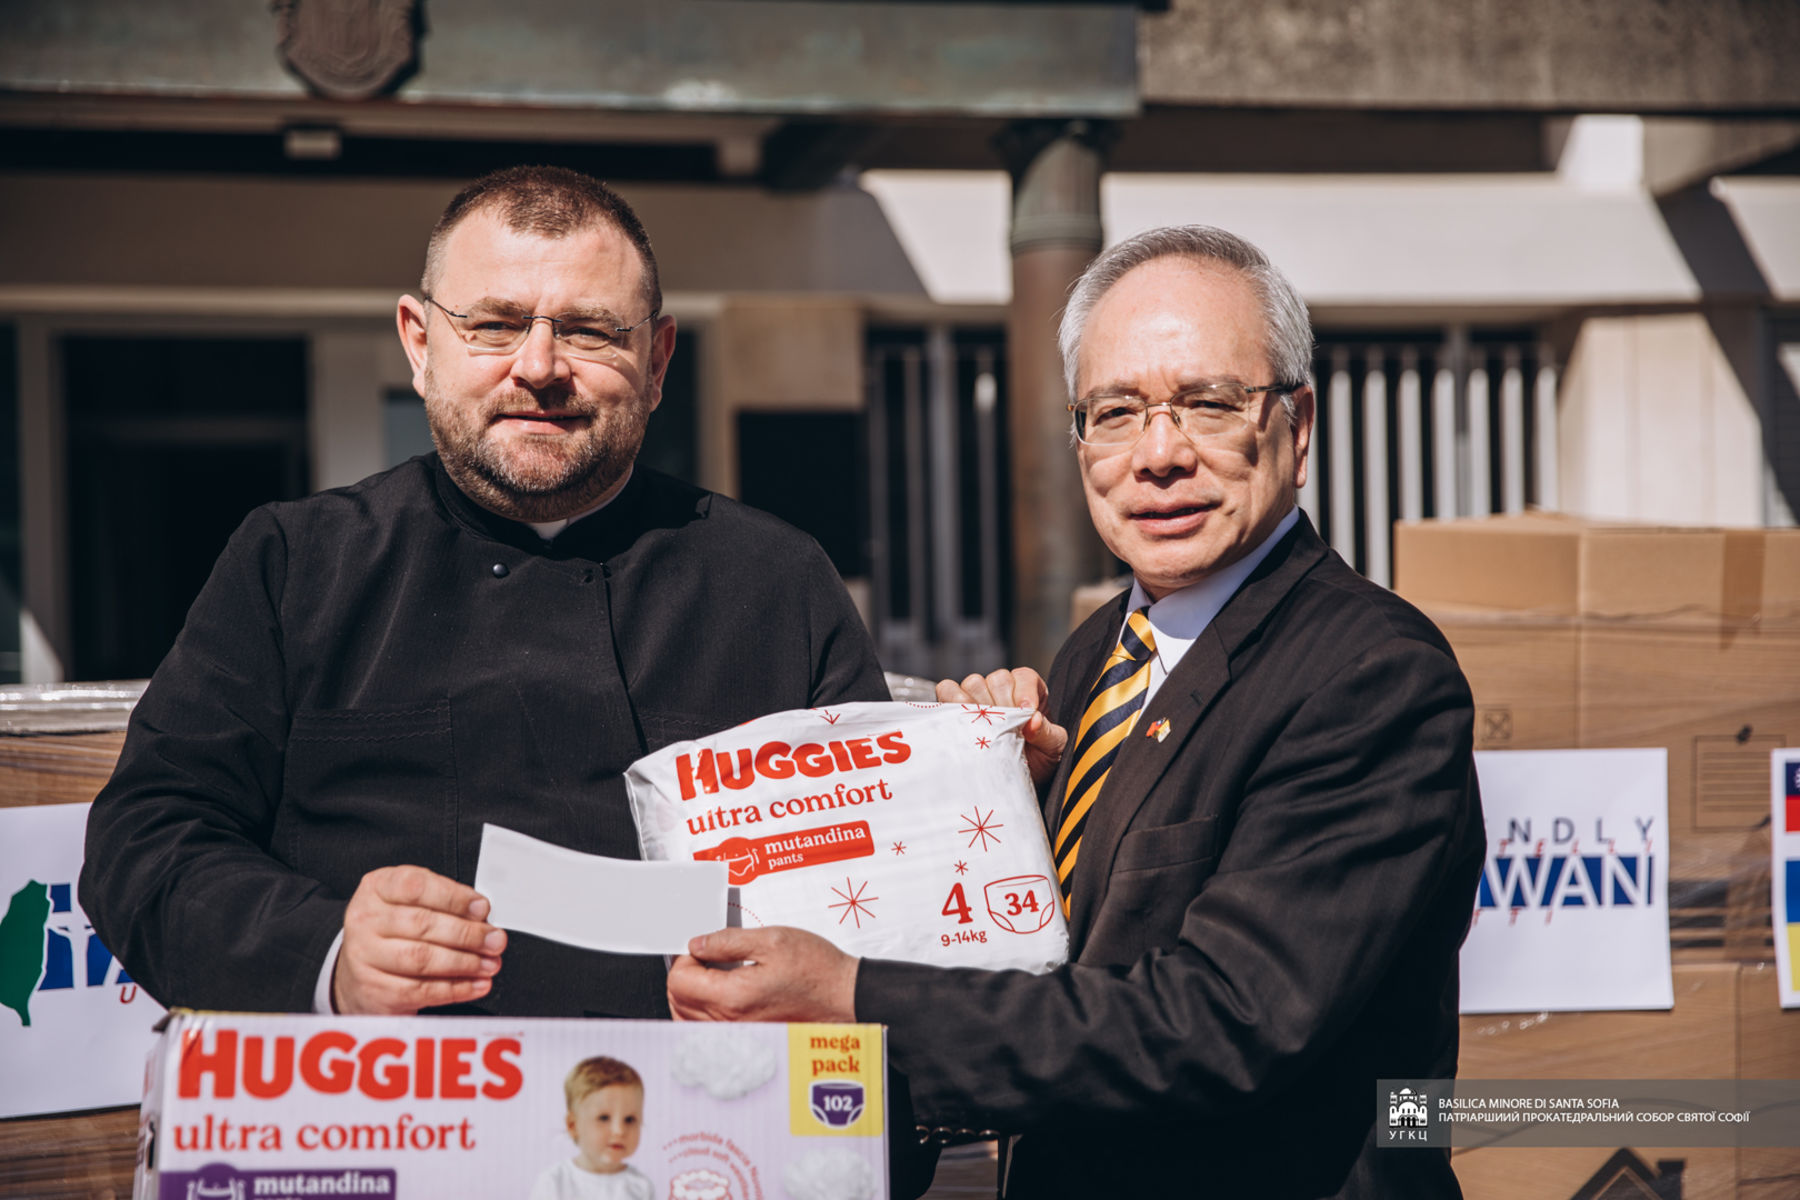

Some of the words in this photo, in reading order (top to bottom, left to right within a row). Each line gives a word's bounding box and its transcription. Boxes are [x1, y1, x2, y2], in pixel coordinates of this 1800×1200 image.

[676, 731, 912, 801] HUGGIES
[686, 805, 763, 835] ultra
[769, 778, 893, 818] comfort
[764, 826, 866, 855] mutandina
[1507, 816, 1654, 844] NDLY
[768, 852, 804, 870] pants
[1482, 854, 1646, 908] WAN
[941, 882, 974, 925] 4
[1004, 889, 1040, 917] 34
[941, 929, 988, 947] 9-14kg
[810, 1035, 861, 1053] mega
[177, 1028, 524, 1102] HUGGIES
[812, 1055, 860, 1076] pack
[823, 1096, 854, 1111] 102
[174, 1113, 282, 1152] ultra
[296, 1113, 476, 1152] comfort
[253, 1171, 391, 1195] mutandina
